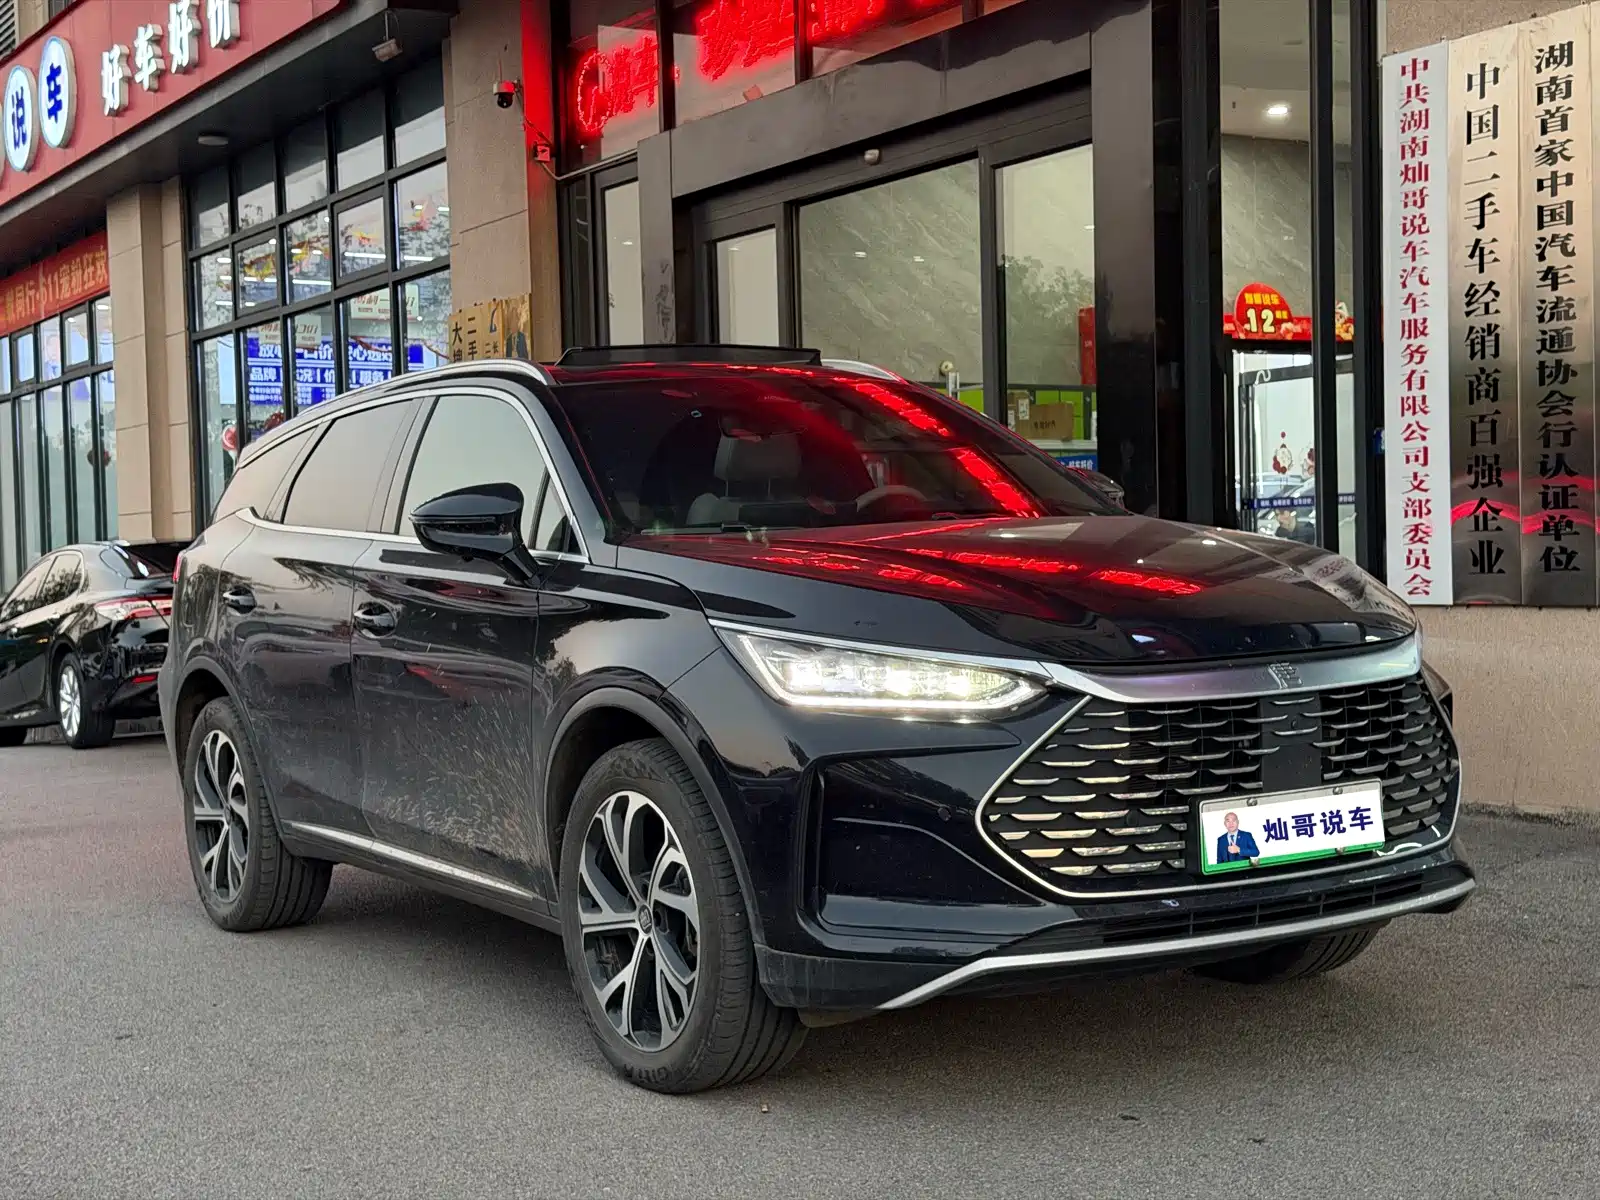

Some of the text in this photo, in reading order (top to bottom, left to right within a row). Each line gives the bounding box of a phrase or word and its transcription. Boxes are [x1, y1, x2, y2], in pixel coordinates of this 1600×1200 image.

[101, 0, 238, 116] 好车好价
[1246, 308, 1275, 333] 12
[1399, 57, 1433, 596] 中共湖南灿哥说车汽车服务有限公司支部委员会
[1463, 62, 1506, 576] 中国二手车经销商百强企业
[1535, 40, 1580, 573] 湖南首家中国汽车流通协会行认证单位
[1263, 806, 1374, 843] 灿哥说车
